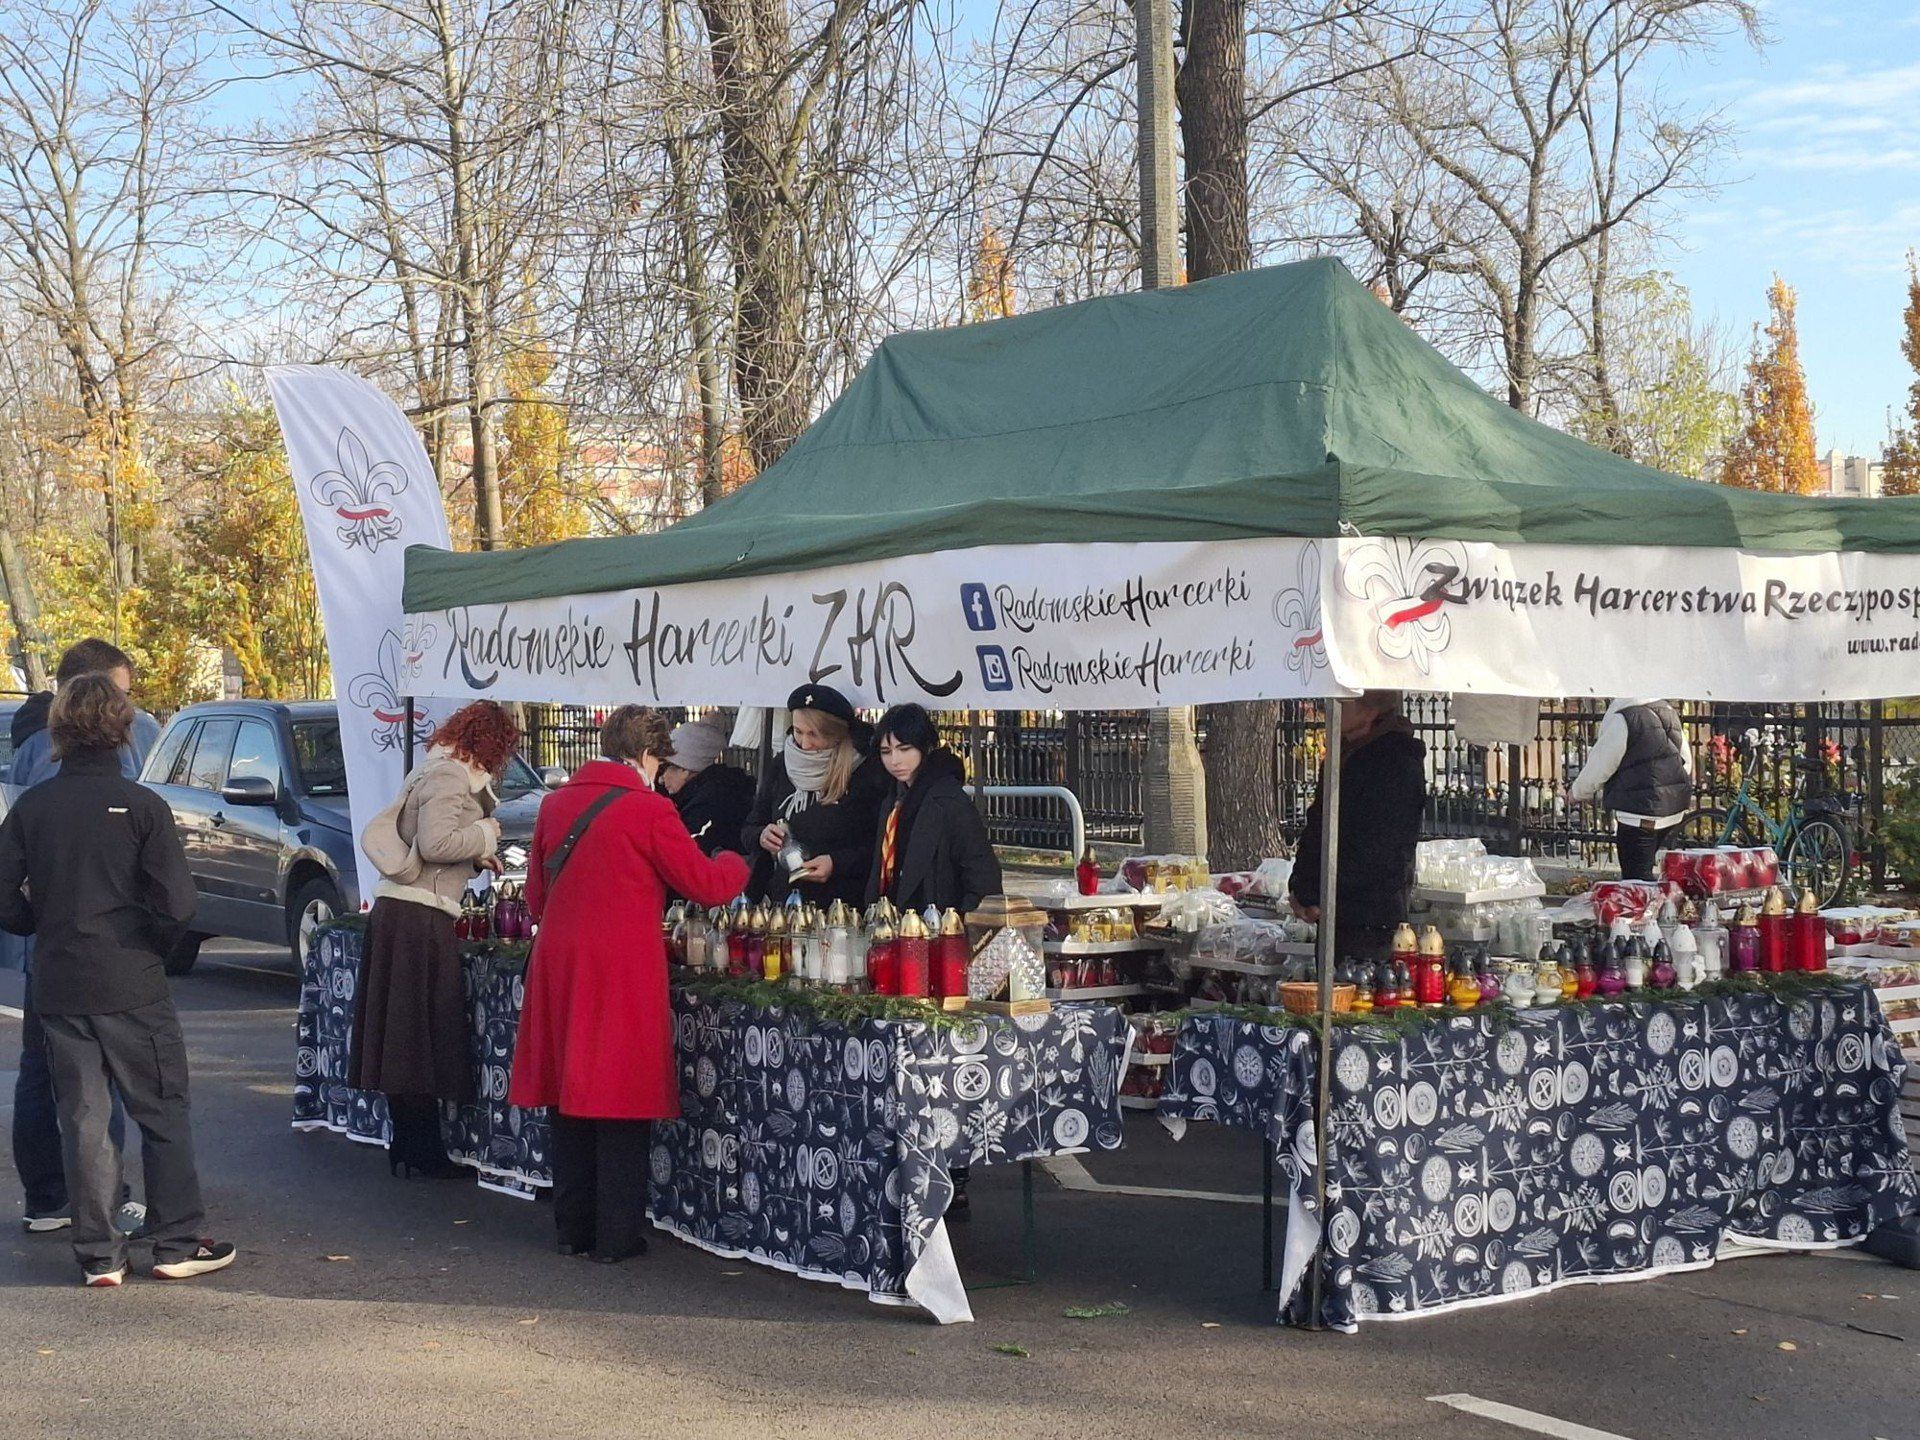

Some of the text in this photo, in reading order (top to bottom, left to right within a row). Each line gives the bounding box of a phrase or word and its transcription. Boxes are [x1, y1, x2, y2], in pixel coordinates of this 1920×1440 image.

[1421, 562, 1564, 616] Związek
[1573, 572, 1757, 617] Harcerstwa
[443, 580, 964, 704] Radomskie Harcerki ZHR
[1846, 630, 1920, 656] www.rad
